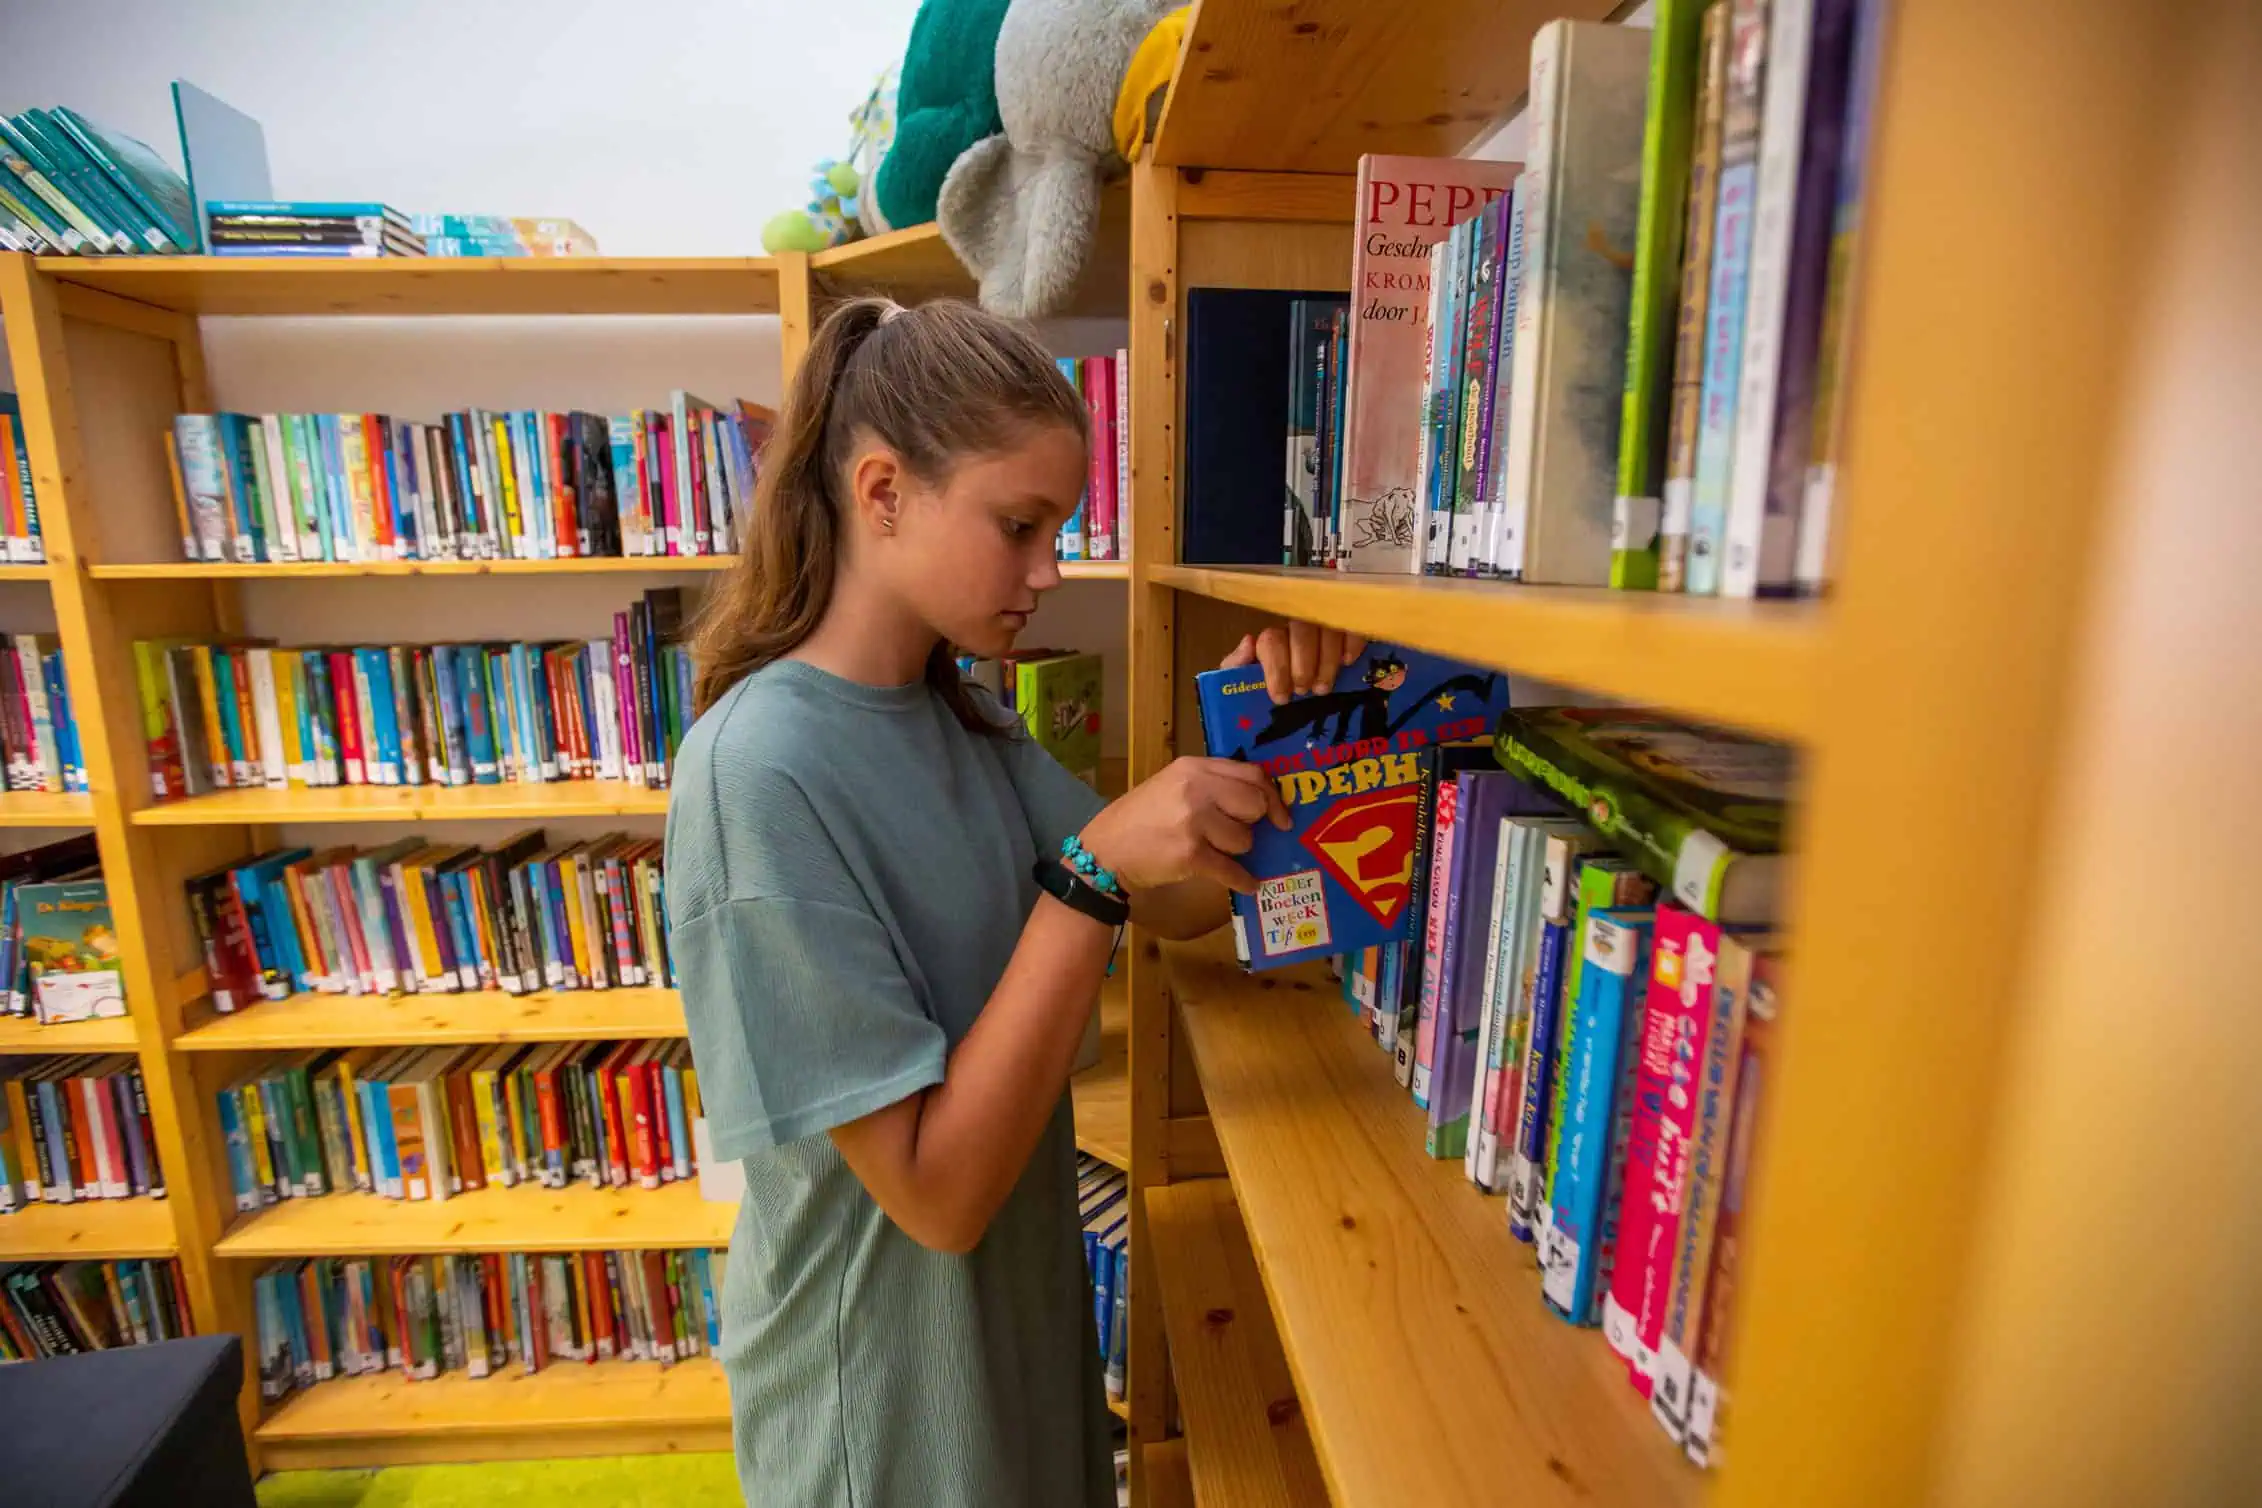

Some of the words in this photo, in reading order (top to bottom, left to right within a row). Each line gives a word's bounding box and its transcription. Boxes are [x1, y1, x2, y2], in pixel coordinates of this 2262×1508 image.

[1363, 298, 1408, 320] door
[1411, 306, 1428, 325] J
[1312, 736, 1388, 768] WORD
[1397, 729, 1429, 750] IK
